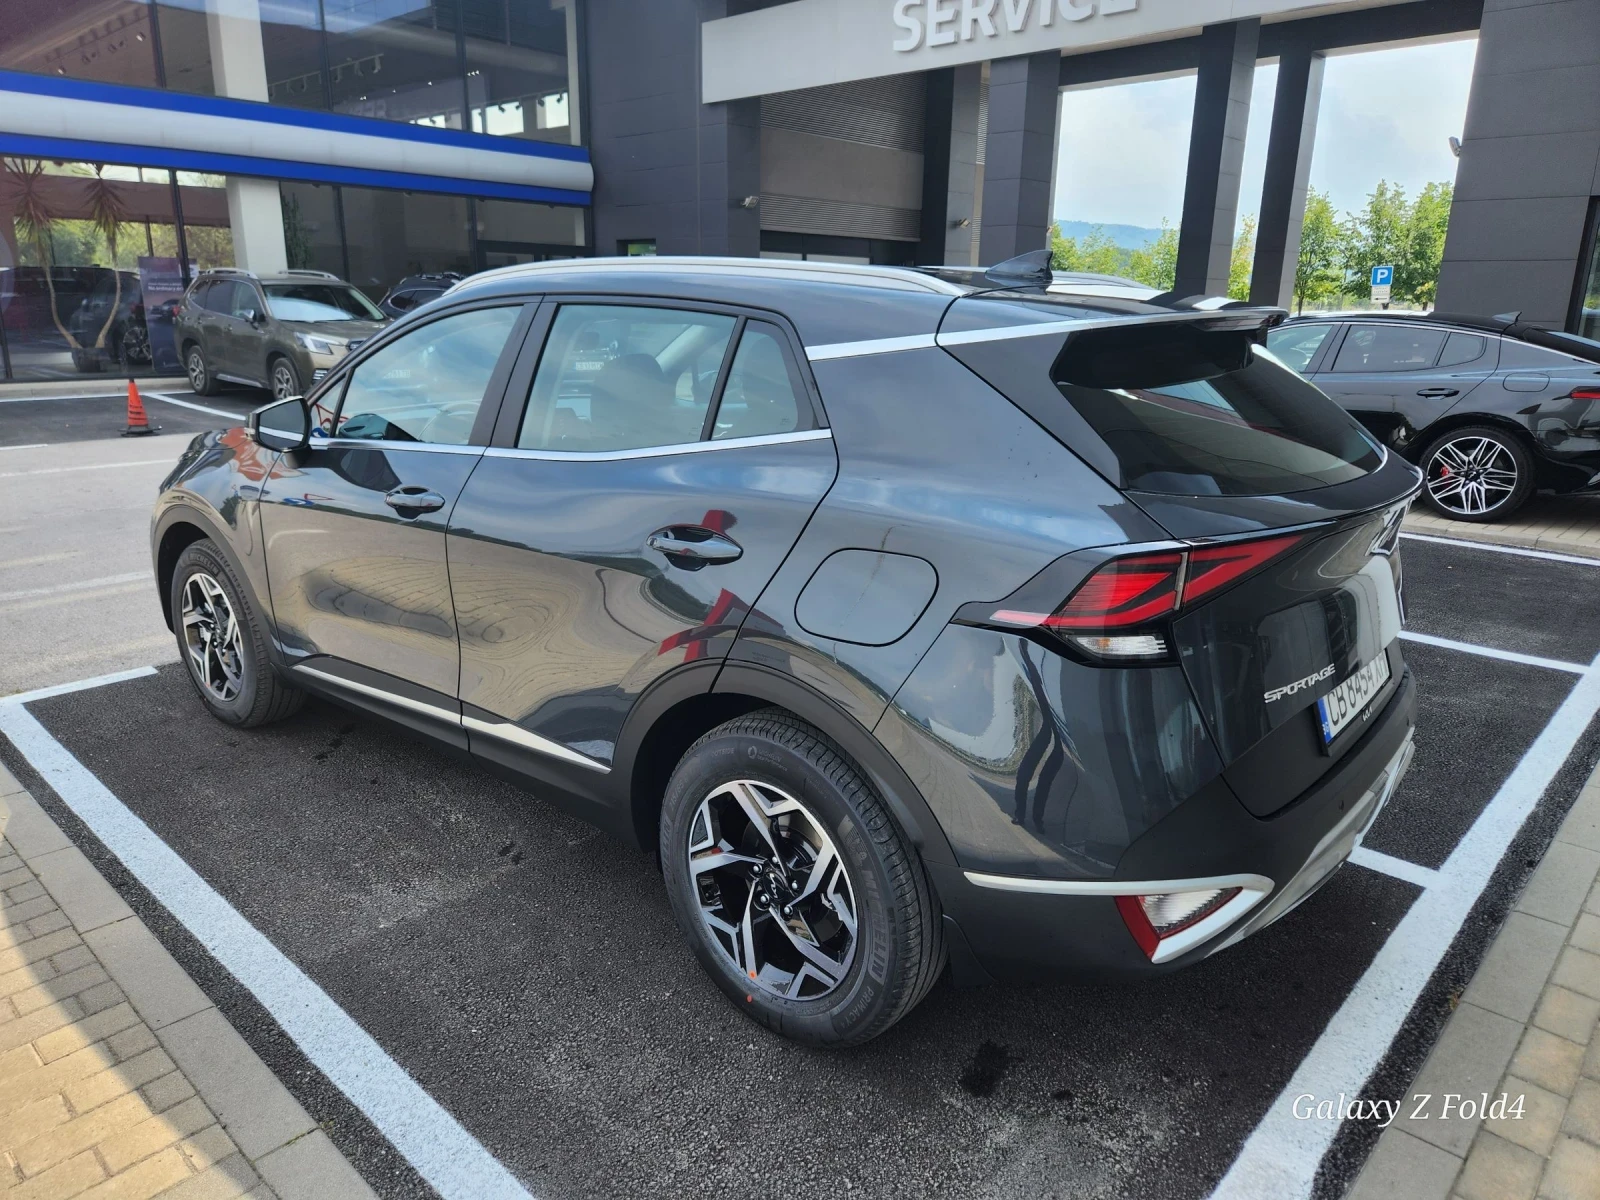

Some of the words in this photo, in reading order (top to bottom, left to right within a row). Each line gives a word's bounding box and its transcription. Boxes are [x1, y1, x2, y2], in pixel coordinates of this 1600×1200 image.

[893, 0, 1138, 51] SERVI
[1377, 269, 1388, 283] P
[1263, 663, 1336, 704] SPORTAGE
[1327, 685, 1348, 727] CB
[1346, 665, 1375, 709] 8454
[861, 869, 888, 985] MICHELIN
[847, 985, 875, 1026] PRIMACY
